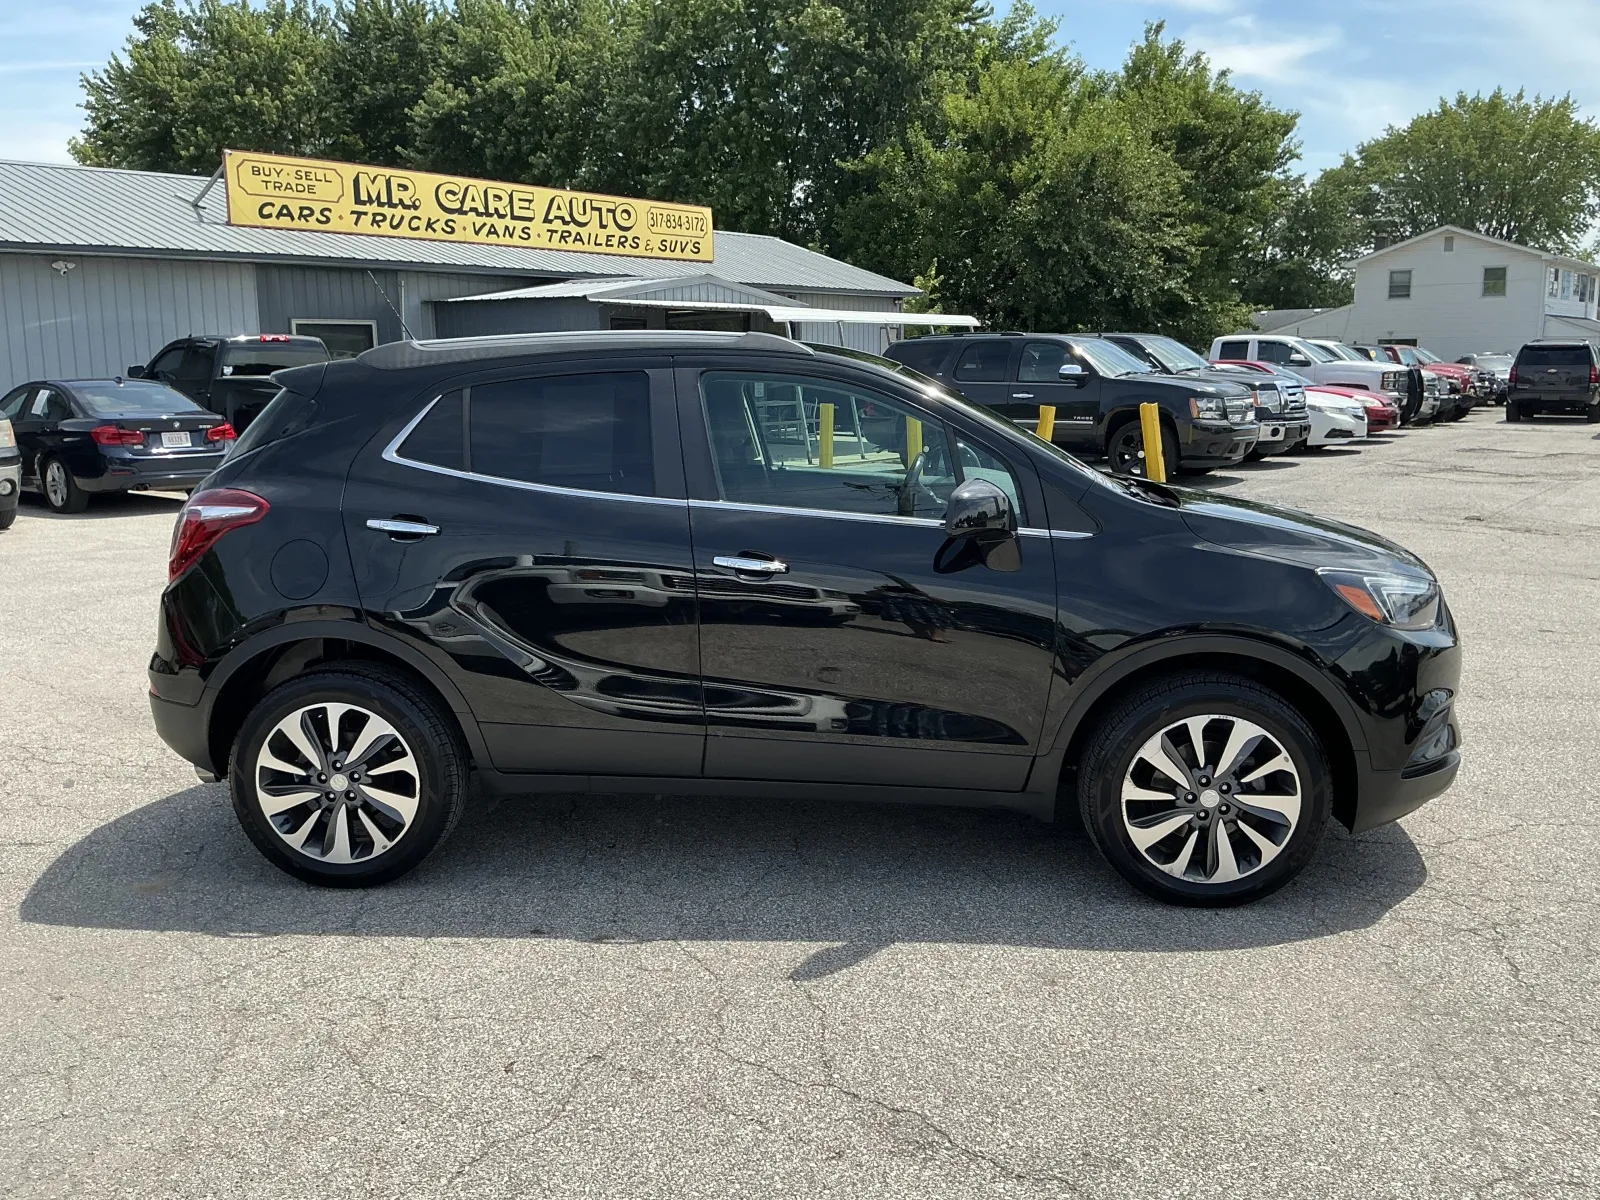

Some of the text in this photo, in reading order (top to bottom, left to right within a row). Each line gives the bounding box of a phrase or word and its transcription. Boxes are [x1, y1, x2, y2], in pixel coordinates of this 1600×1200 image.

[251, 165, 333, 183] BUY SELL
[261, 179, 317, 194] TRADE
[352, 171, 638, 232] MR. CARE AUTO
[257, 202, 333, 225] CARS
[349, 210, 457, 235] TRUCKS
[472, 221, 531, 241] VANS
[546, 229, 641, 250] TRAILERS
[657, 239, 701, 254] SUV'S
